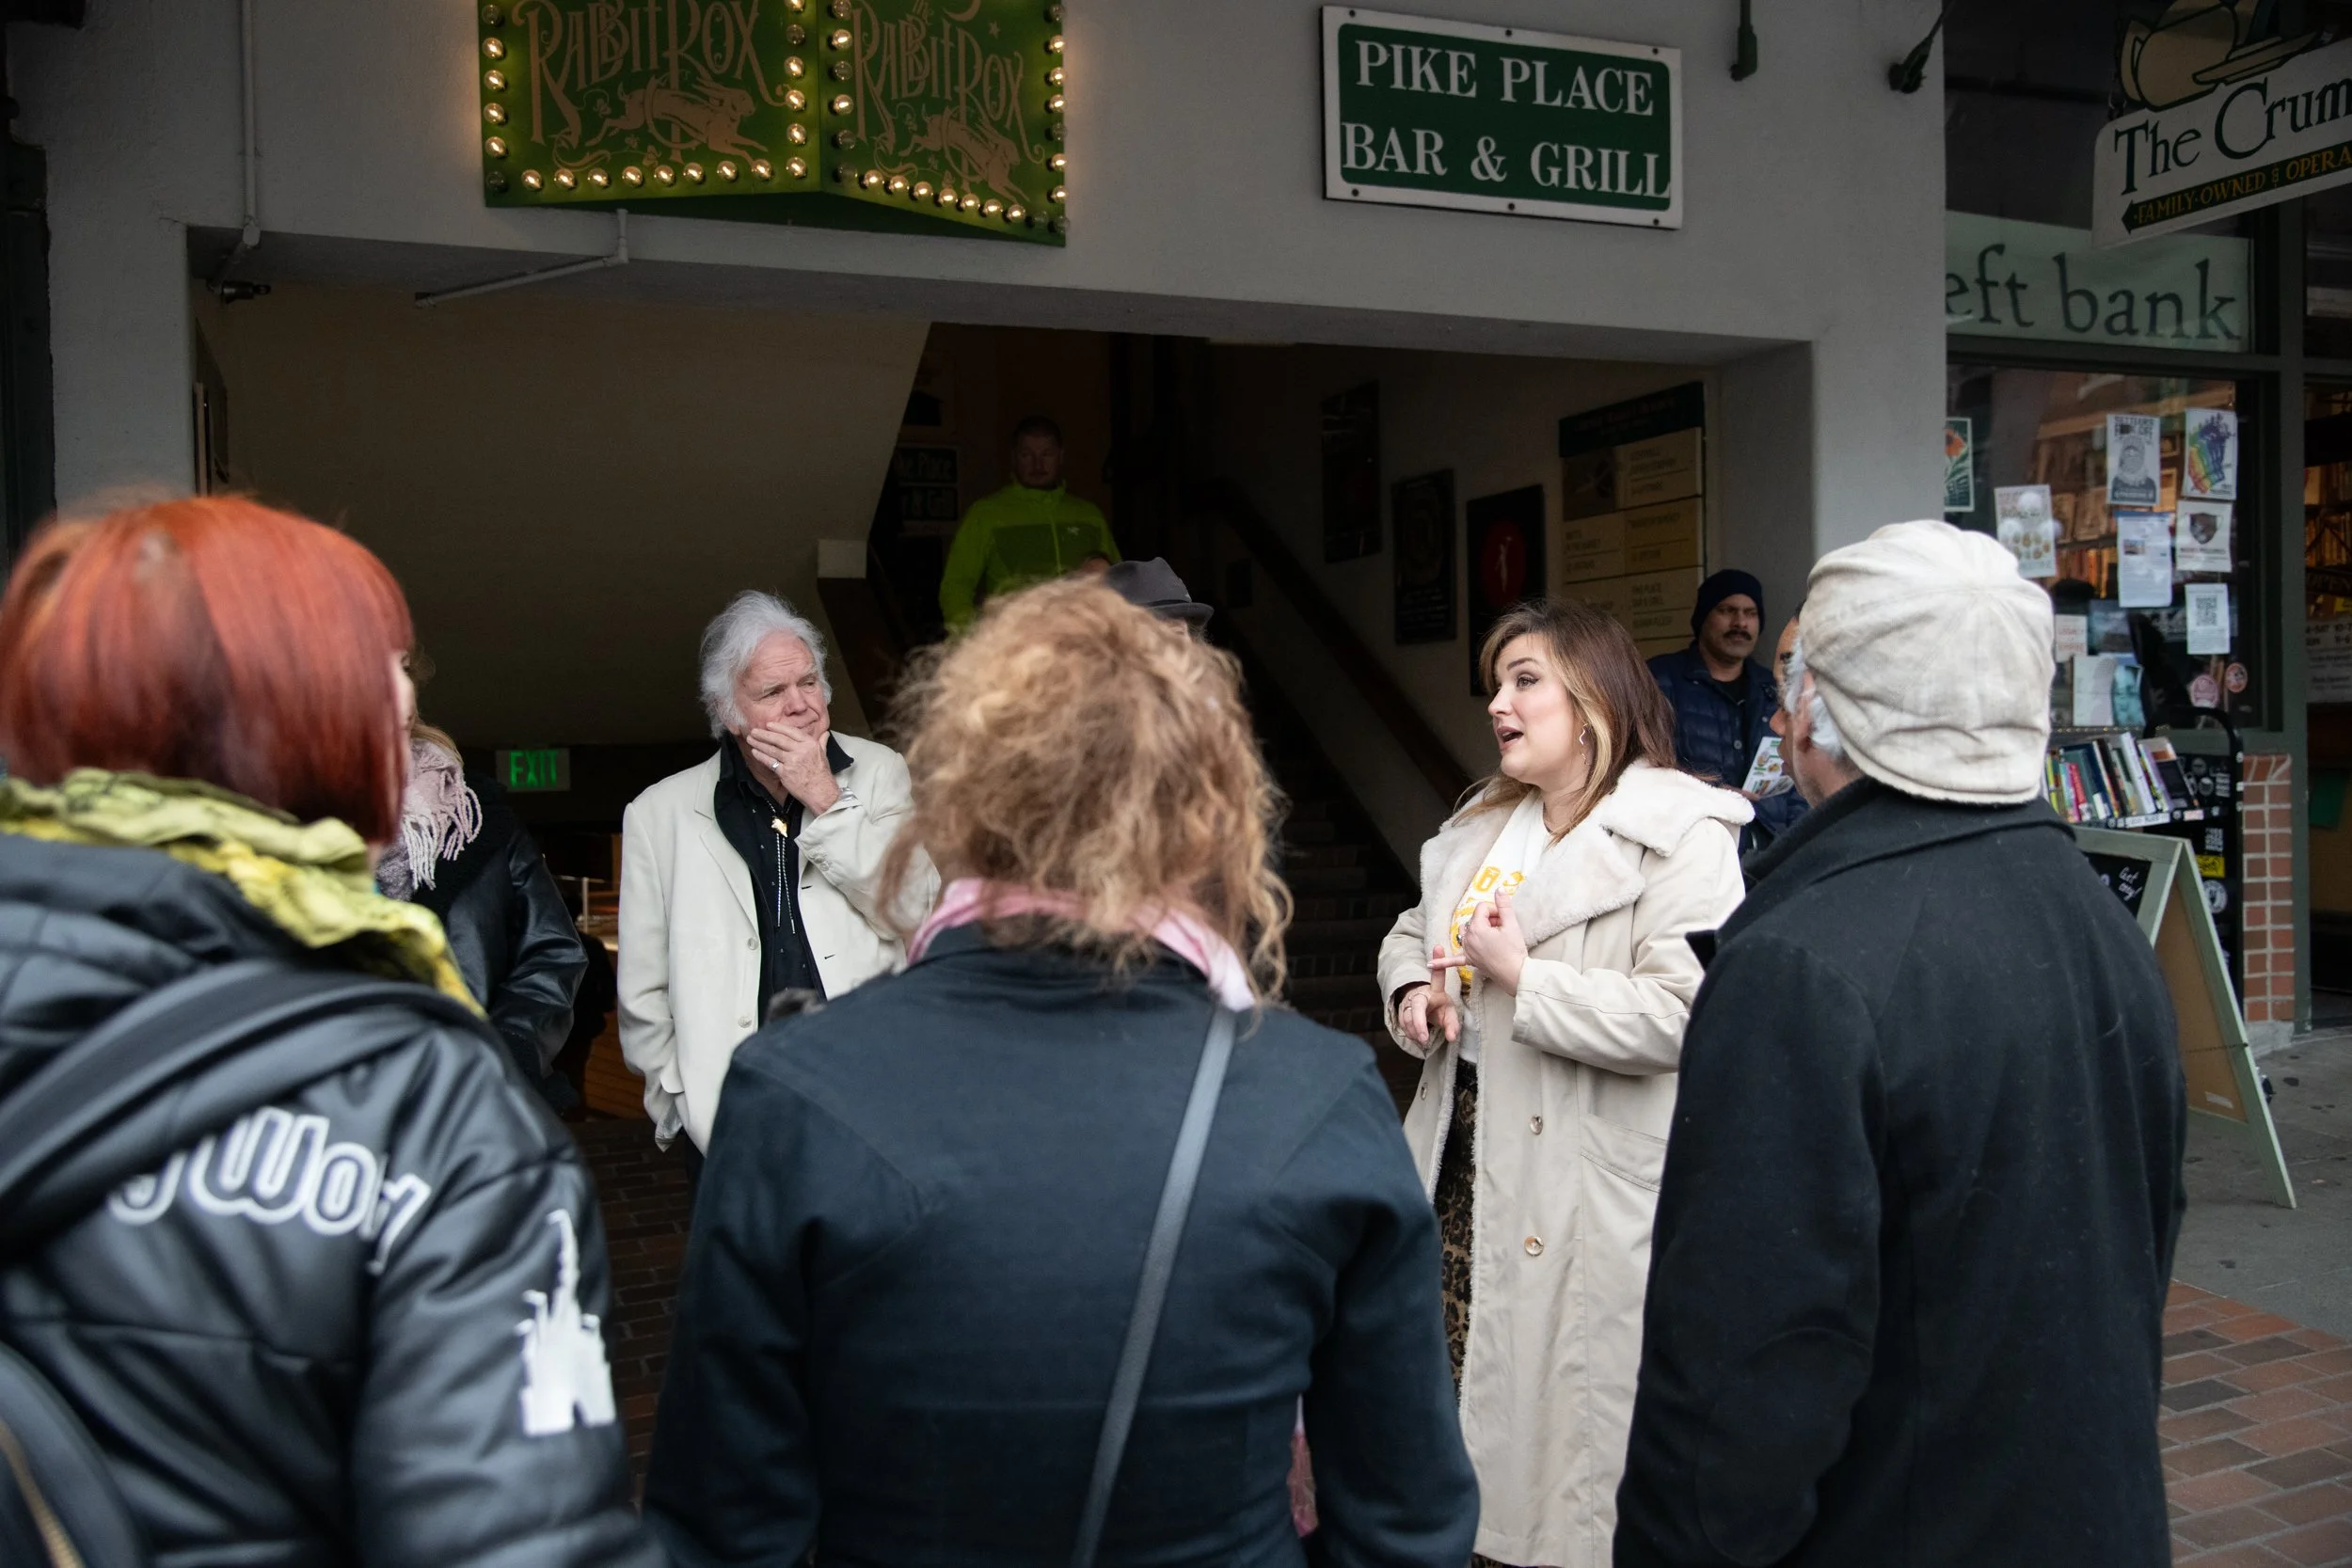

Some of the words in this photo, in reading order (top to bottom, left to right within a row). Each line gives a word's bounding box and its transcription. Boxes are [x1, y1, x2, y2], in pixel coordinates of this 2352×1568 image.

[1356, 40, 1477, 98] PIKE
[1500, 56, 1654, 116] PLACE
[1342, 122, 1448, 177] BAR
[1470, 135, 1507, 182] &
[1531, 141, 1671, 198] GRILL
[2115, 119, 2201, 196] The
[2053, 252, 2241, 341] bank
[509, 751, 559, 787] EXIT
